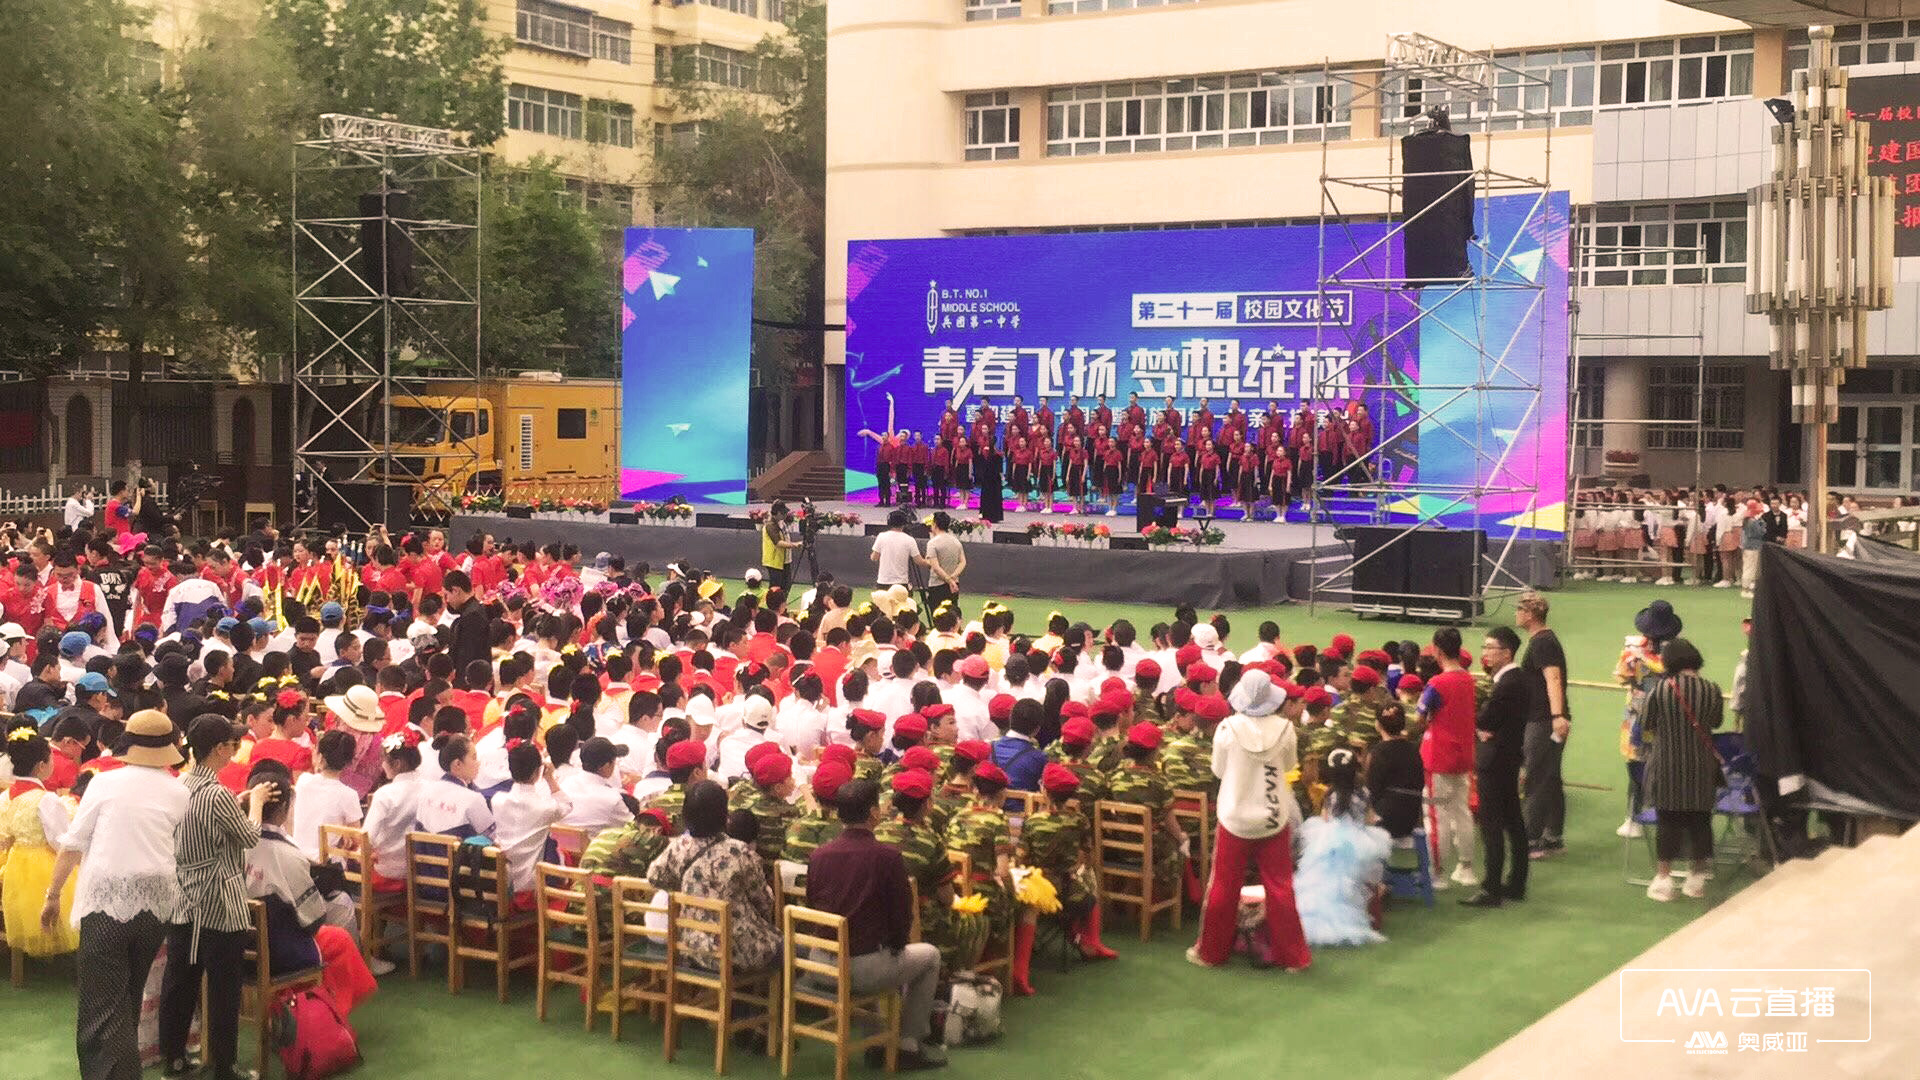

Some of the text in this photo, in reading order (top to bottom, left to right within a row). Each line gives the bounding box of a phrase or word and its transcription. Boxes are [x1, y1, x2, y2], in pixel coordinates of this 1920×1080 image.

[1846, 106, 1920, 120] 十一届校
[942, 302, 1020, 312] MIDDLE SCHOOL
[1138, 299, 1344, 320] 第二十一届 校园文化节
[922, 338, 1351, 411] 青春飞扬 梦想绽放
